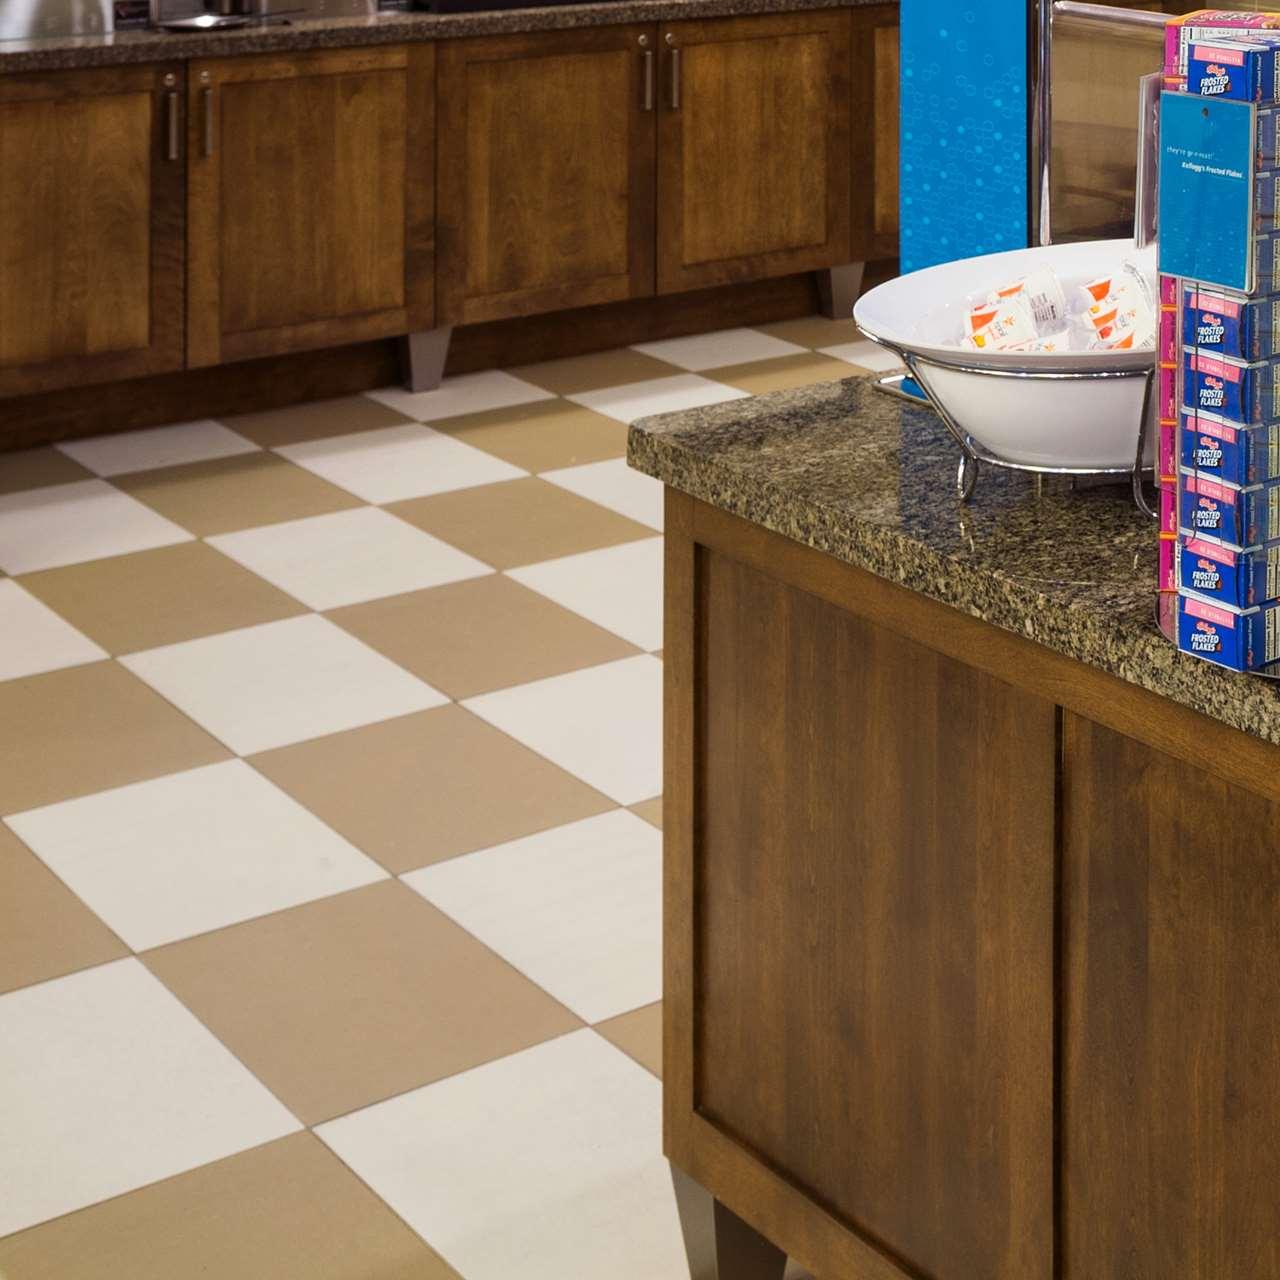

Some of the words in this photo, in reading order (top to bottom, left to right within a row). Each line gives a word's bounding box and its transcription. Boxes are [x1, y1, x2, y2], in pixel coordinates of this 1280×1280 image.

[1200, 75, 1229, 87] FROSTED
[1200, 84, 1225, 96] FLAKES
[1200, 397, 1222, 407] FLAKES
[1192, 571, 1220, 581] FROSTED
[1193, 579, 1216, 589] FLAKES
[1191, 633, 1220, 644] FROSTED
[1192, 642, 1216, 652] FLAKES
